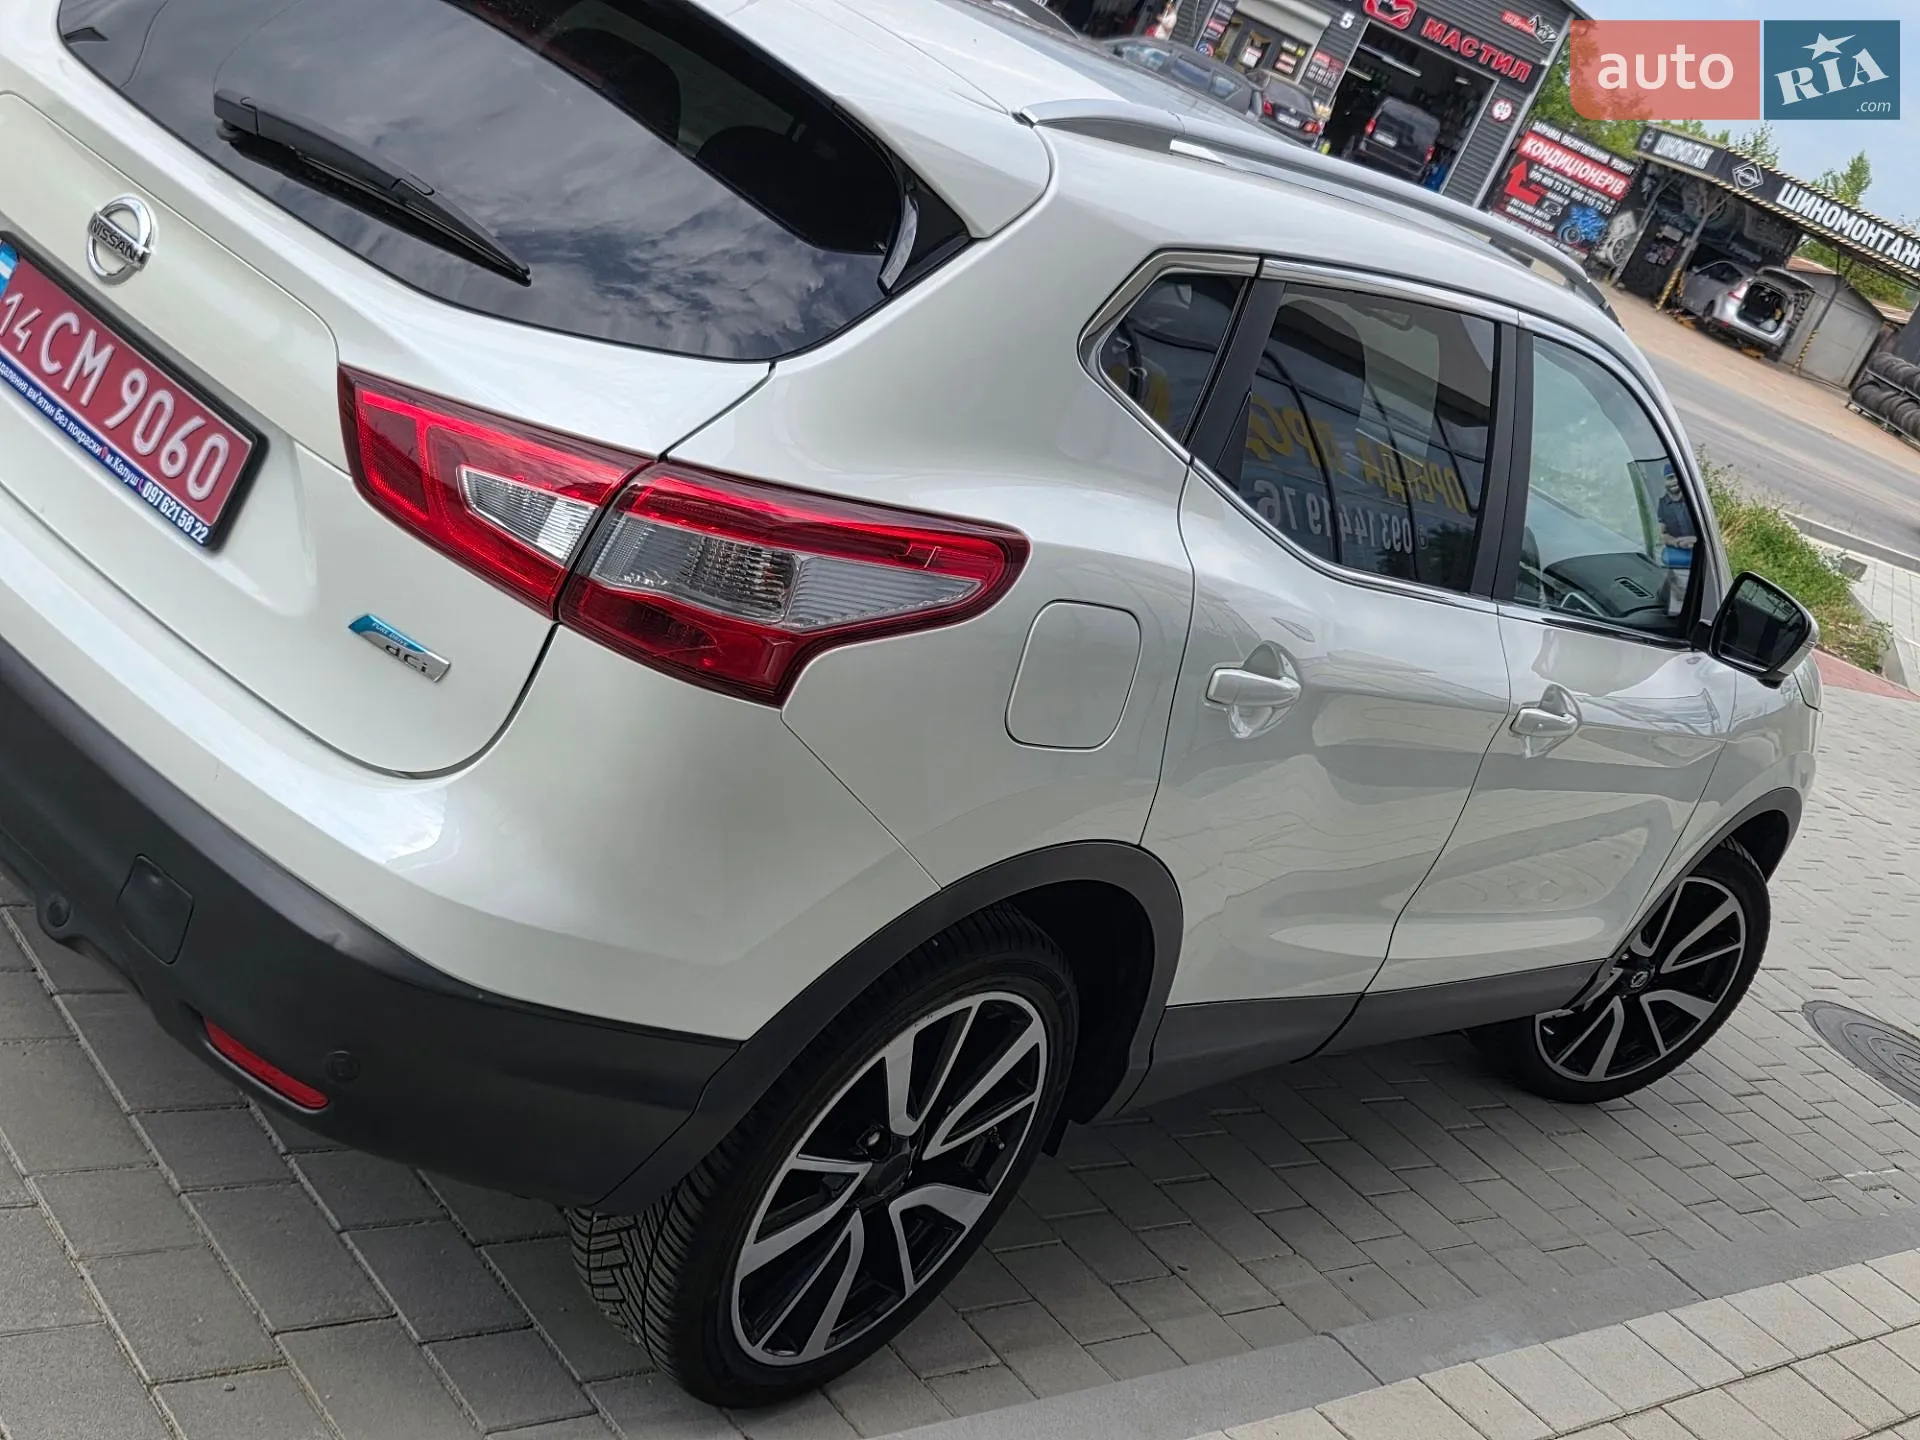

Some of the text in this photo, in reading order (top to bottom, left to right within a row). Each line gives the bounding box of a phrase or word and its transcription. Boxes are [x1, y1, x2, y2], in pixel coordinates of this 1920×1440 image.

[1340, 11, 1355, 29] 5
[1420, 16, 1533, 83] МАСТИЛ
[1522, 137, 1627, 196] КОНДИЦІОНЕРІВ
[91, 219, 138, 260] NISSAN
[1776, 181, 1920, 269] ШИНОМОНТАЖ
[0, 293, 230, 502] 14 CM 9060
[54, 408, 69, 427] без
[67, 422, 103, 456] покраски
[141, 482, 165, 507] 097
[160, 497, 182, 522] 621
[177, 511, 195, 533] 58
[191, 523, 209, 545] 22
